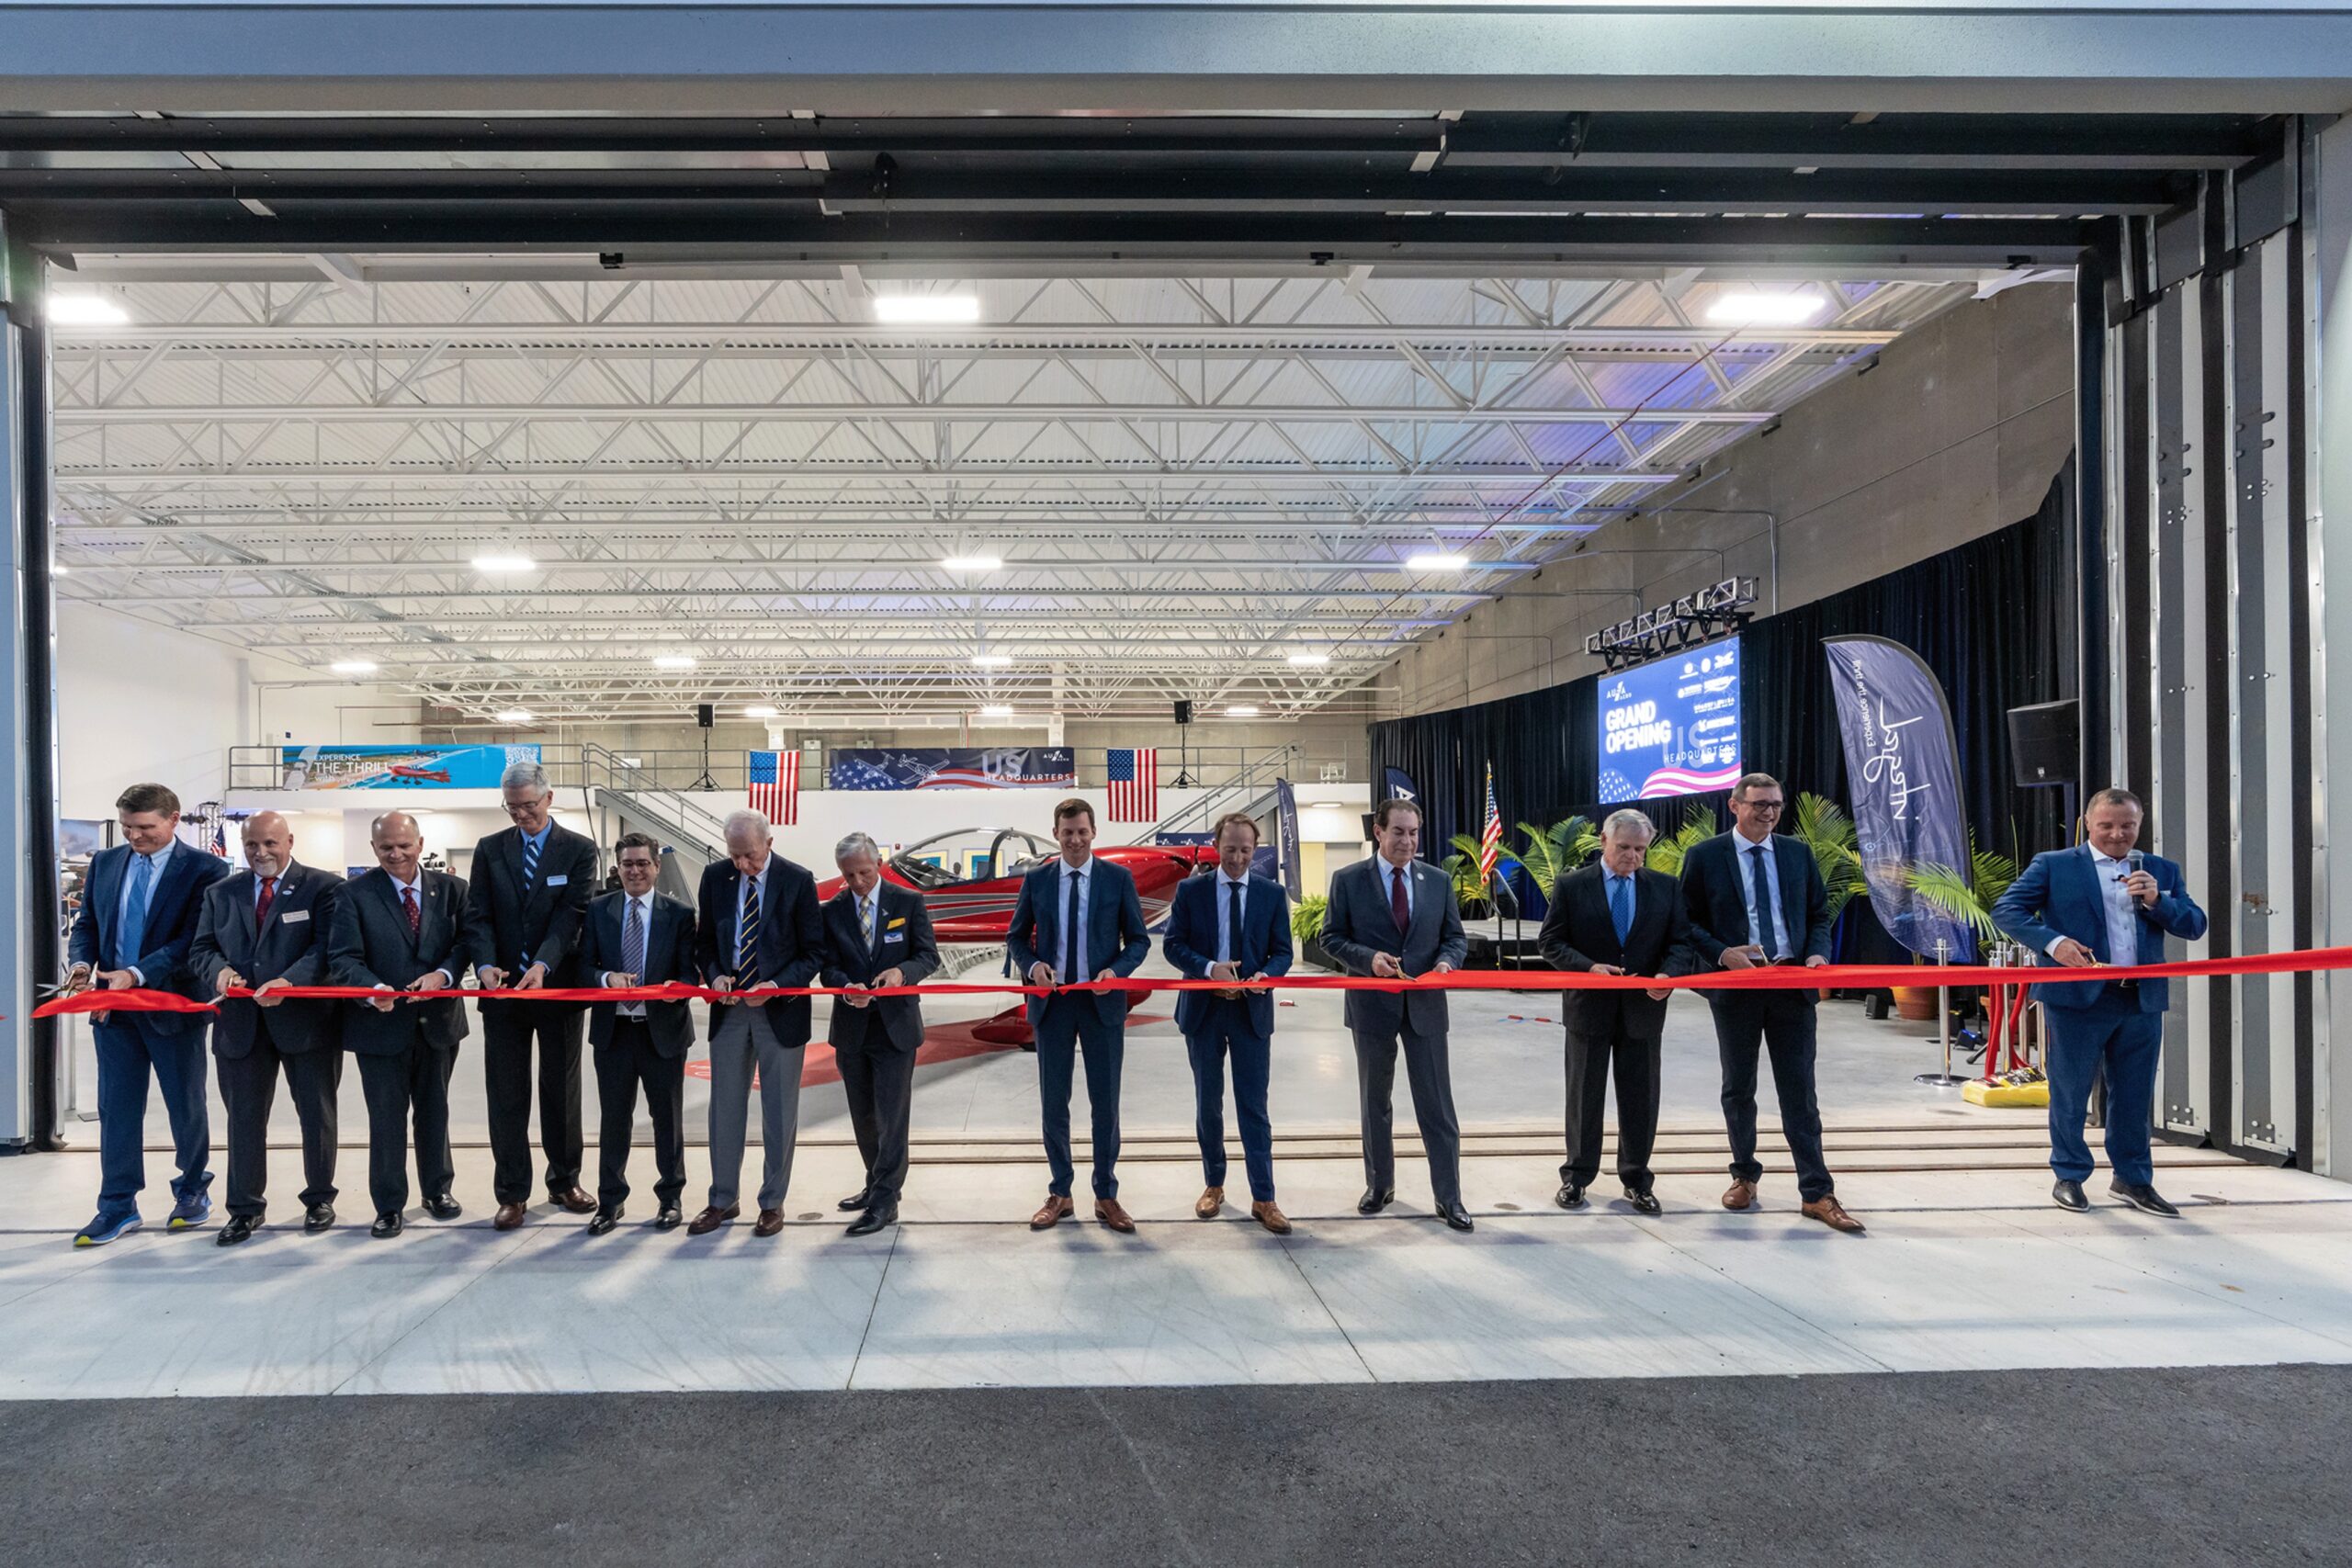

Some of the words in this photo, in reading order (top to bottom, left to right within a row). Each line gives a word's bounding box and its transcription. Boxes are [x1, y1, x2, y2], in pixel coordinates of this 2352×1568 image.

[1605, 700, 1657, 731] GRAND
[1605, 720, 1672, 754] OPENING
[313, 753, 362, 761] EXPERIENCE
[982, 753, 1023, 776] US
[313, 761, 341, 773] THE
[984, 773, 1070, 782] HEADQUARTERS
